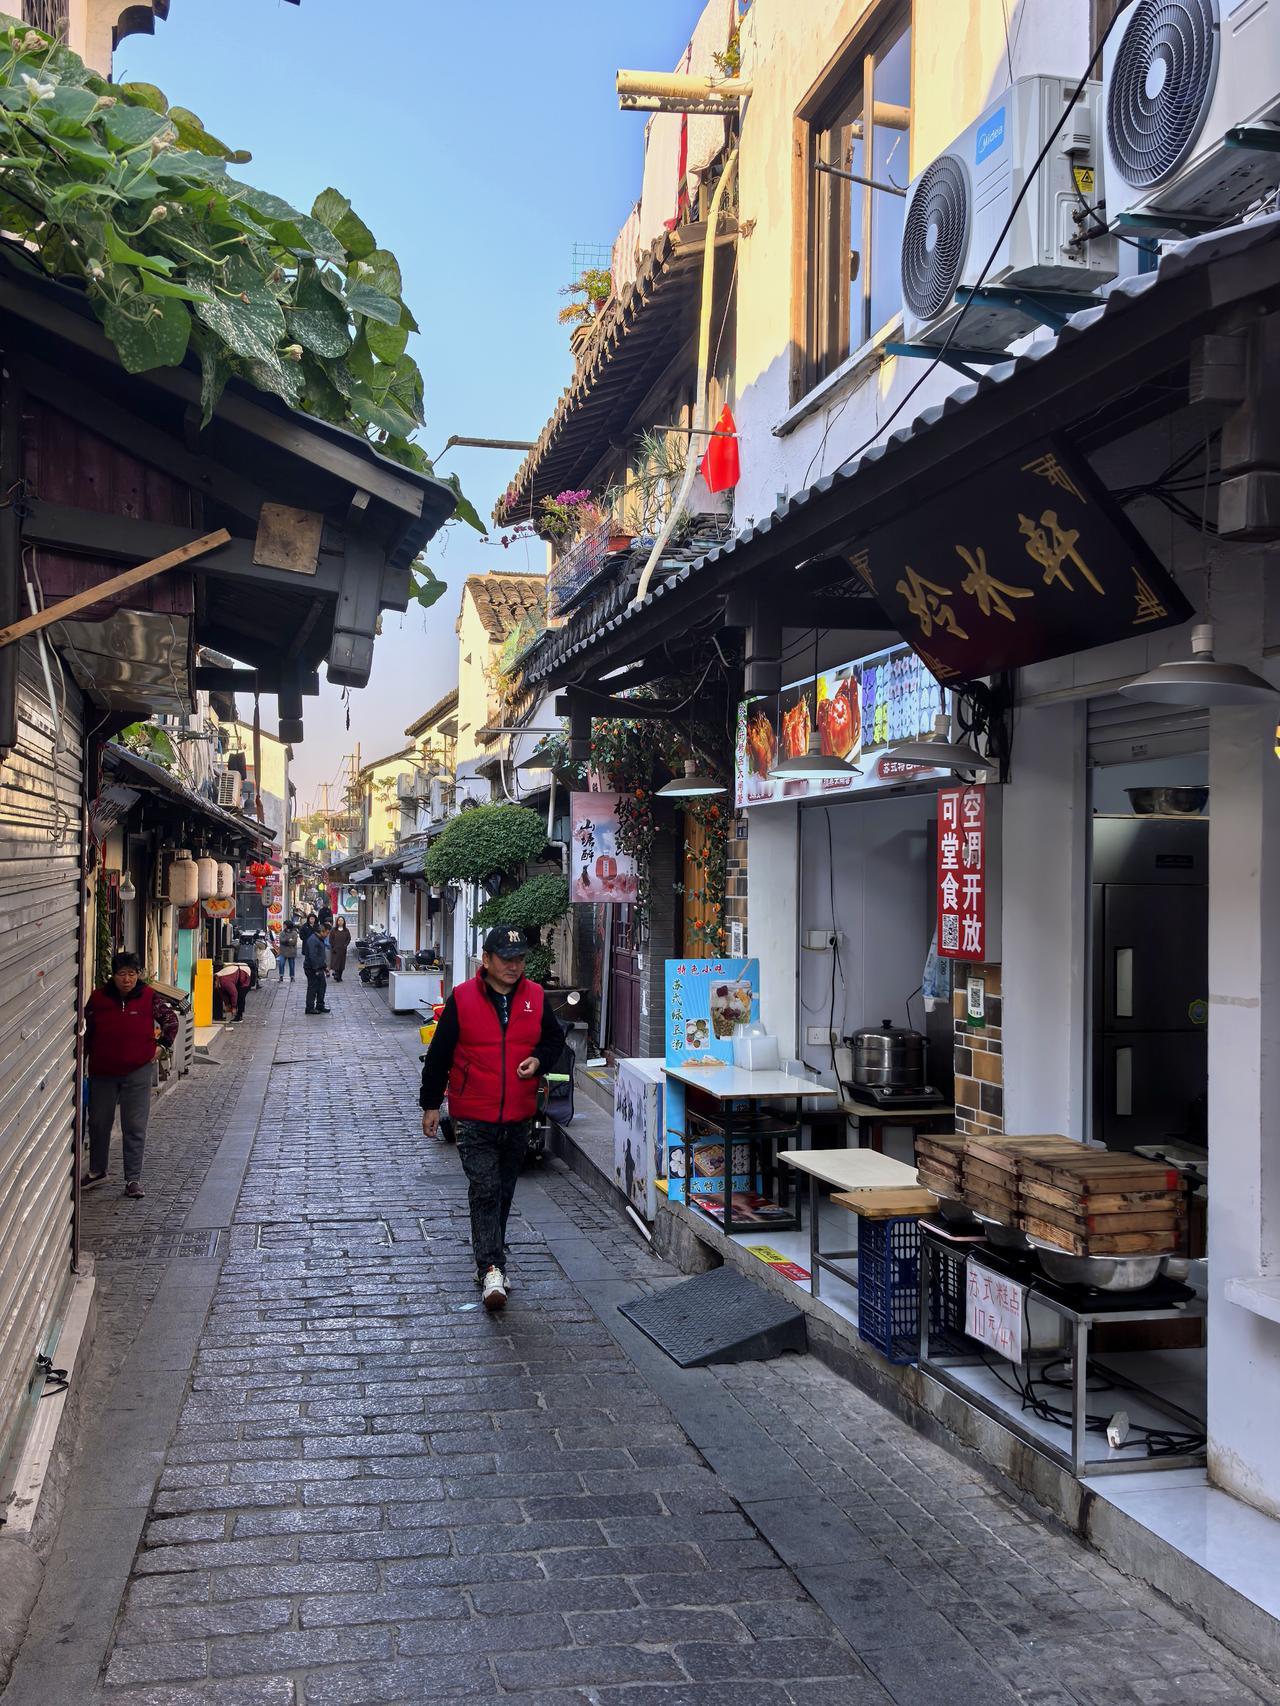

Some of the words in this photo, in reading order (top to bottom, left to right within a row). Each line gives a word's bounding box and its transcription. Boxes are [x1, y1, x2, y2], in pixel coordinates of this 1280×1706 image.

[580, 818, 596, 864] 山塘醉
[941, 792, 959, 911] 可堂食
[962, 789, 982, 954] 空调开放
[677, 964, 726, 976] 特色小吃
[671, 979, 684, 1051] 苏式绿豆汤
